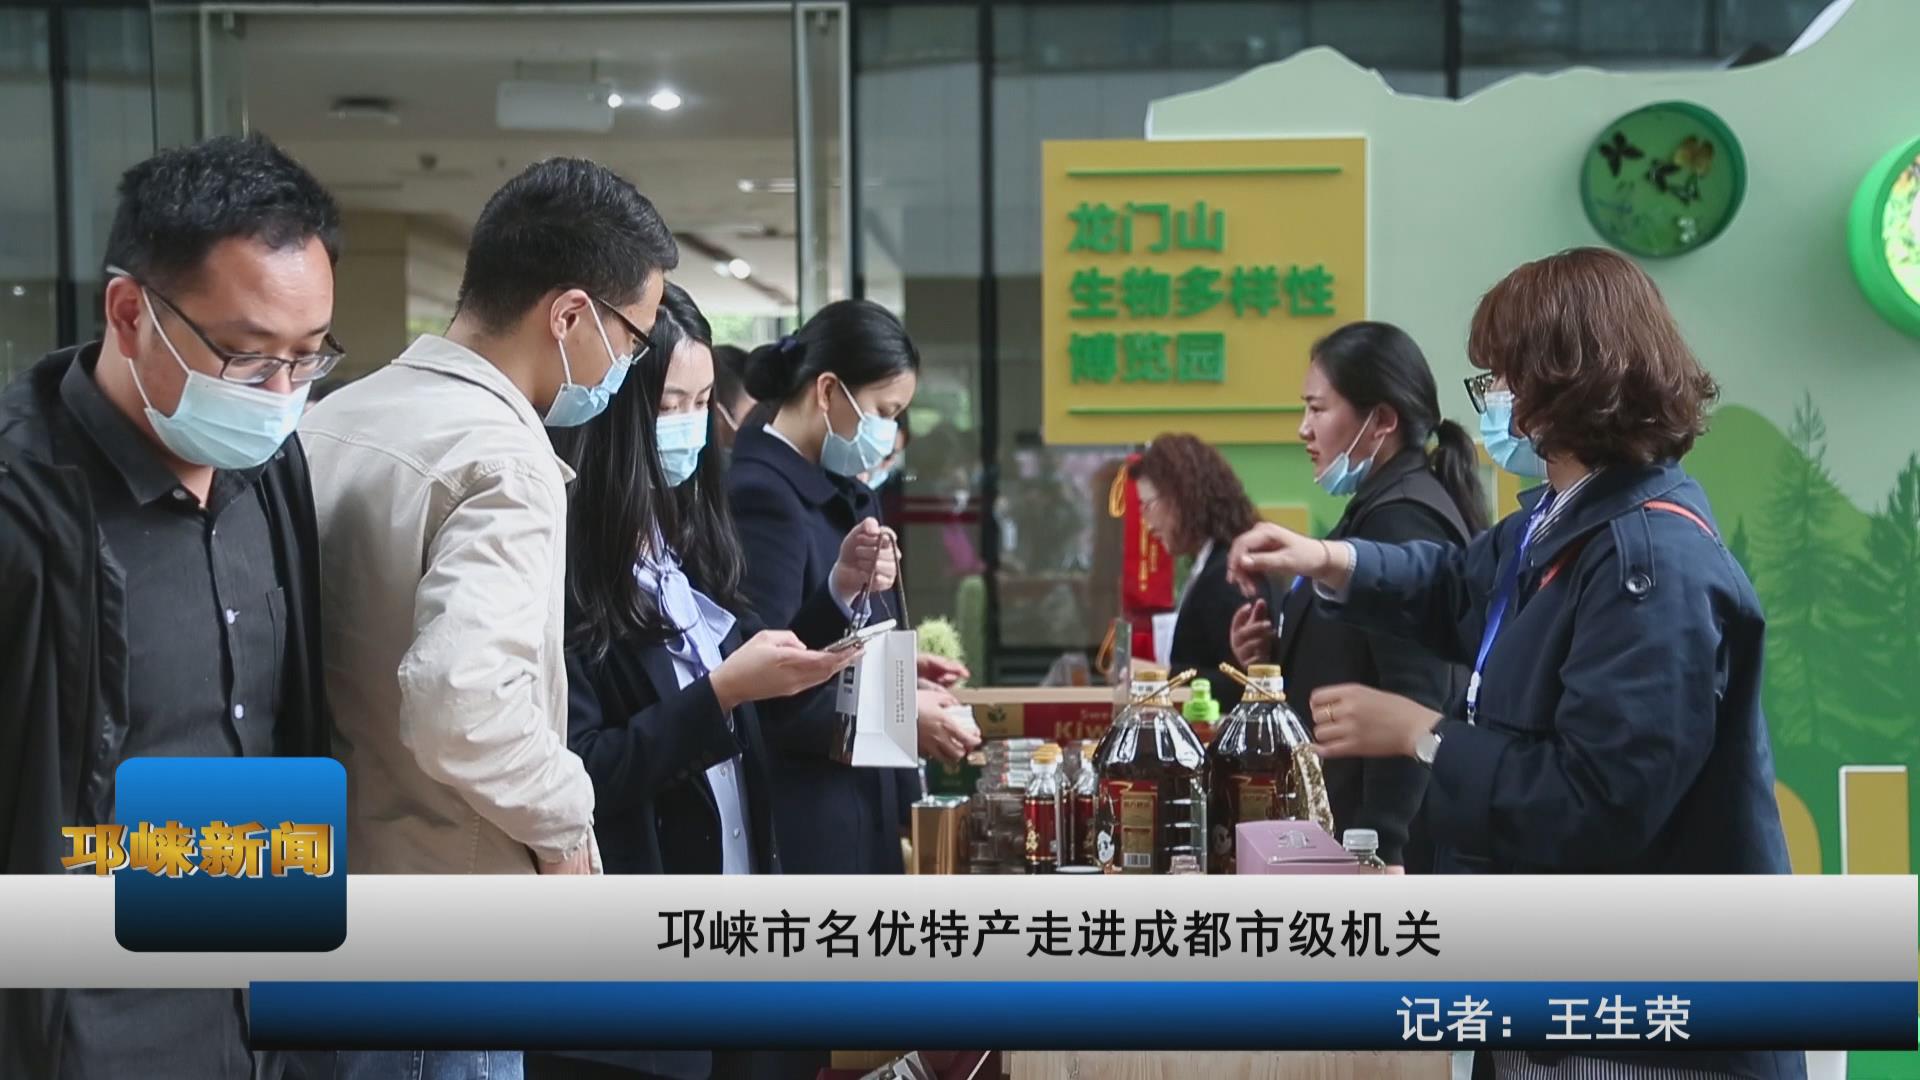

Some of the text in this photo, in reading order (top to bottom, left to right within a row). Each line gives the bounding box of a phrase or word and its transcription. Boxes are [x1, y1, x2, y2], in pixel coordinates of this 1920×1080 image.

[1067, 201, 1226, 254] 龙门山
[1068, 264, 1336, 320] 生物多样性
[1067, 331, 1226, 385] 博览园
